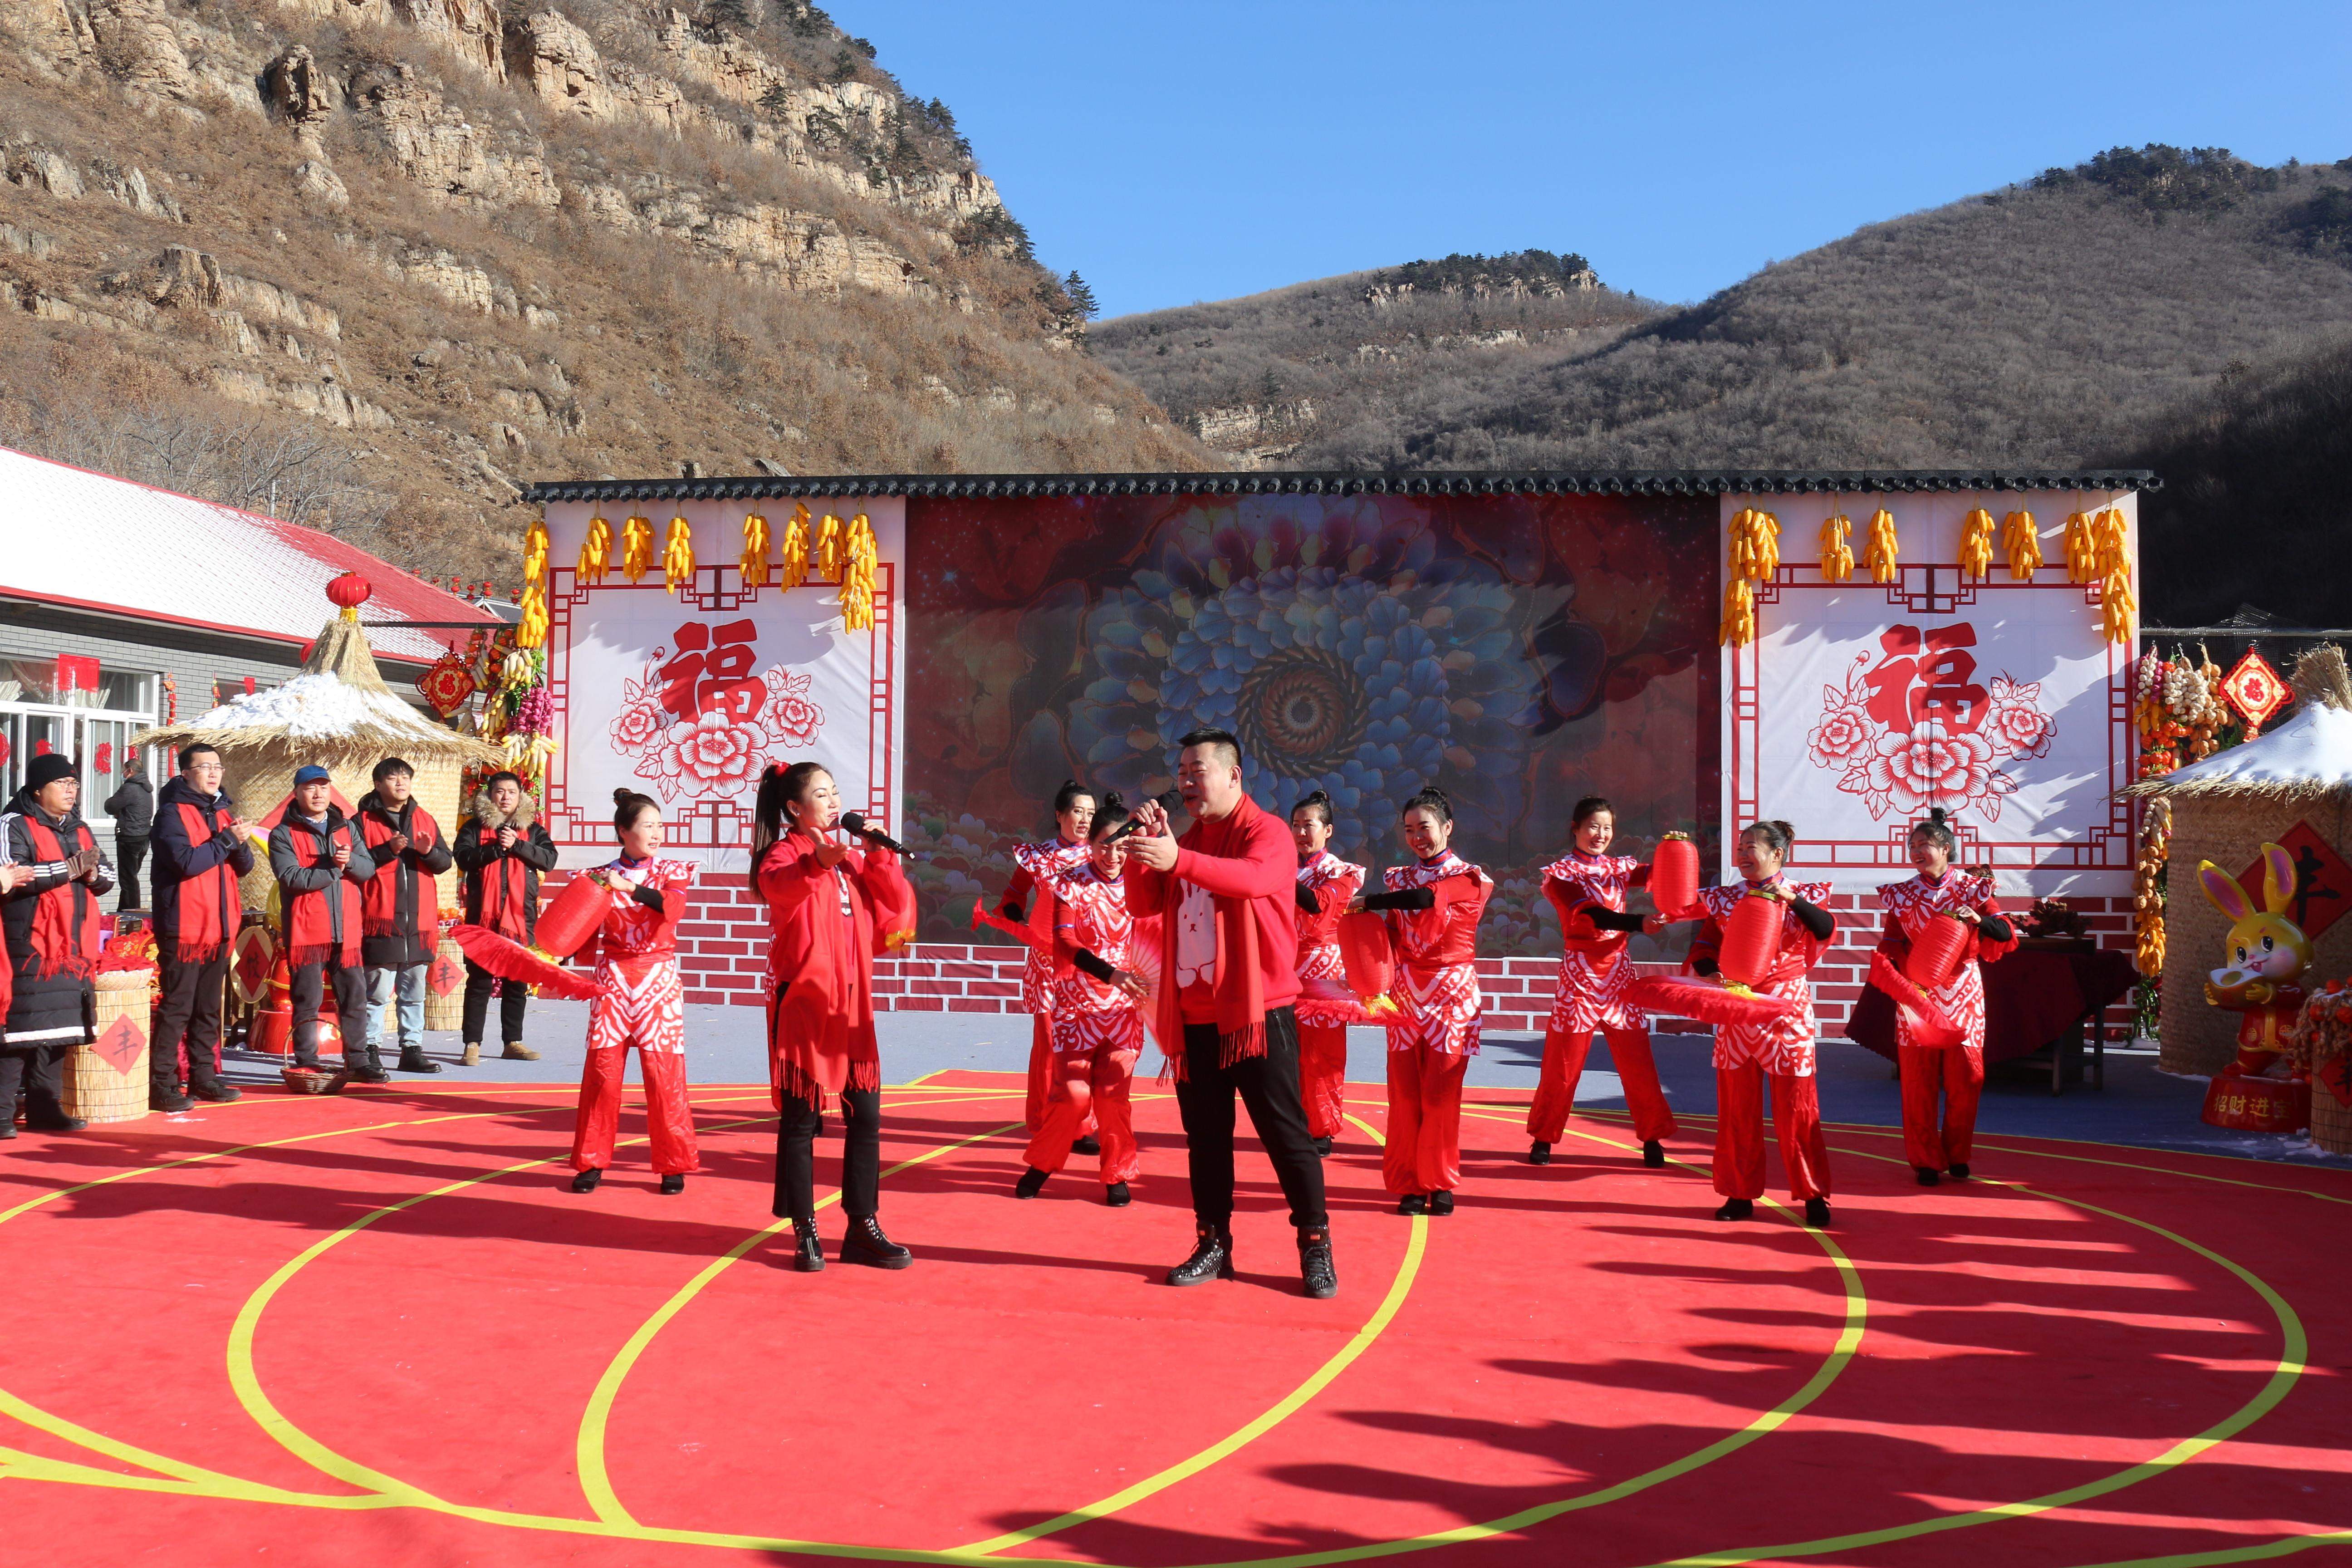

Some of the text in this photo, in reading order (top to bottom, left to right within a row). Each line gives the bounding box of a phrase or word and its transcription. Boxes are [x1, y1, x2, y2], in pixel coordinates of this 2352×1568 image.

[659, 619, 768, 725] 福
[1865, 622, 1990, 732] 福
[2244, 678, 2264, 702] 福
[434, 962, 456, 989] 丰
[113, 1024, 138, 1063] 丰
[2214, 1093, 2292, 1118] 招财进宝
